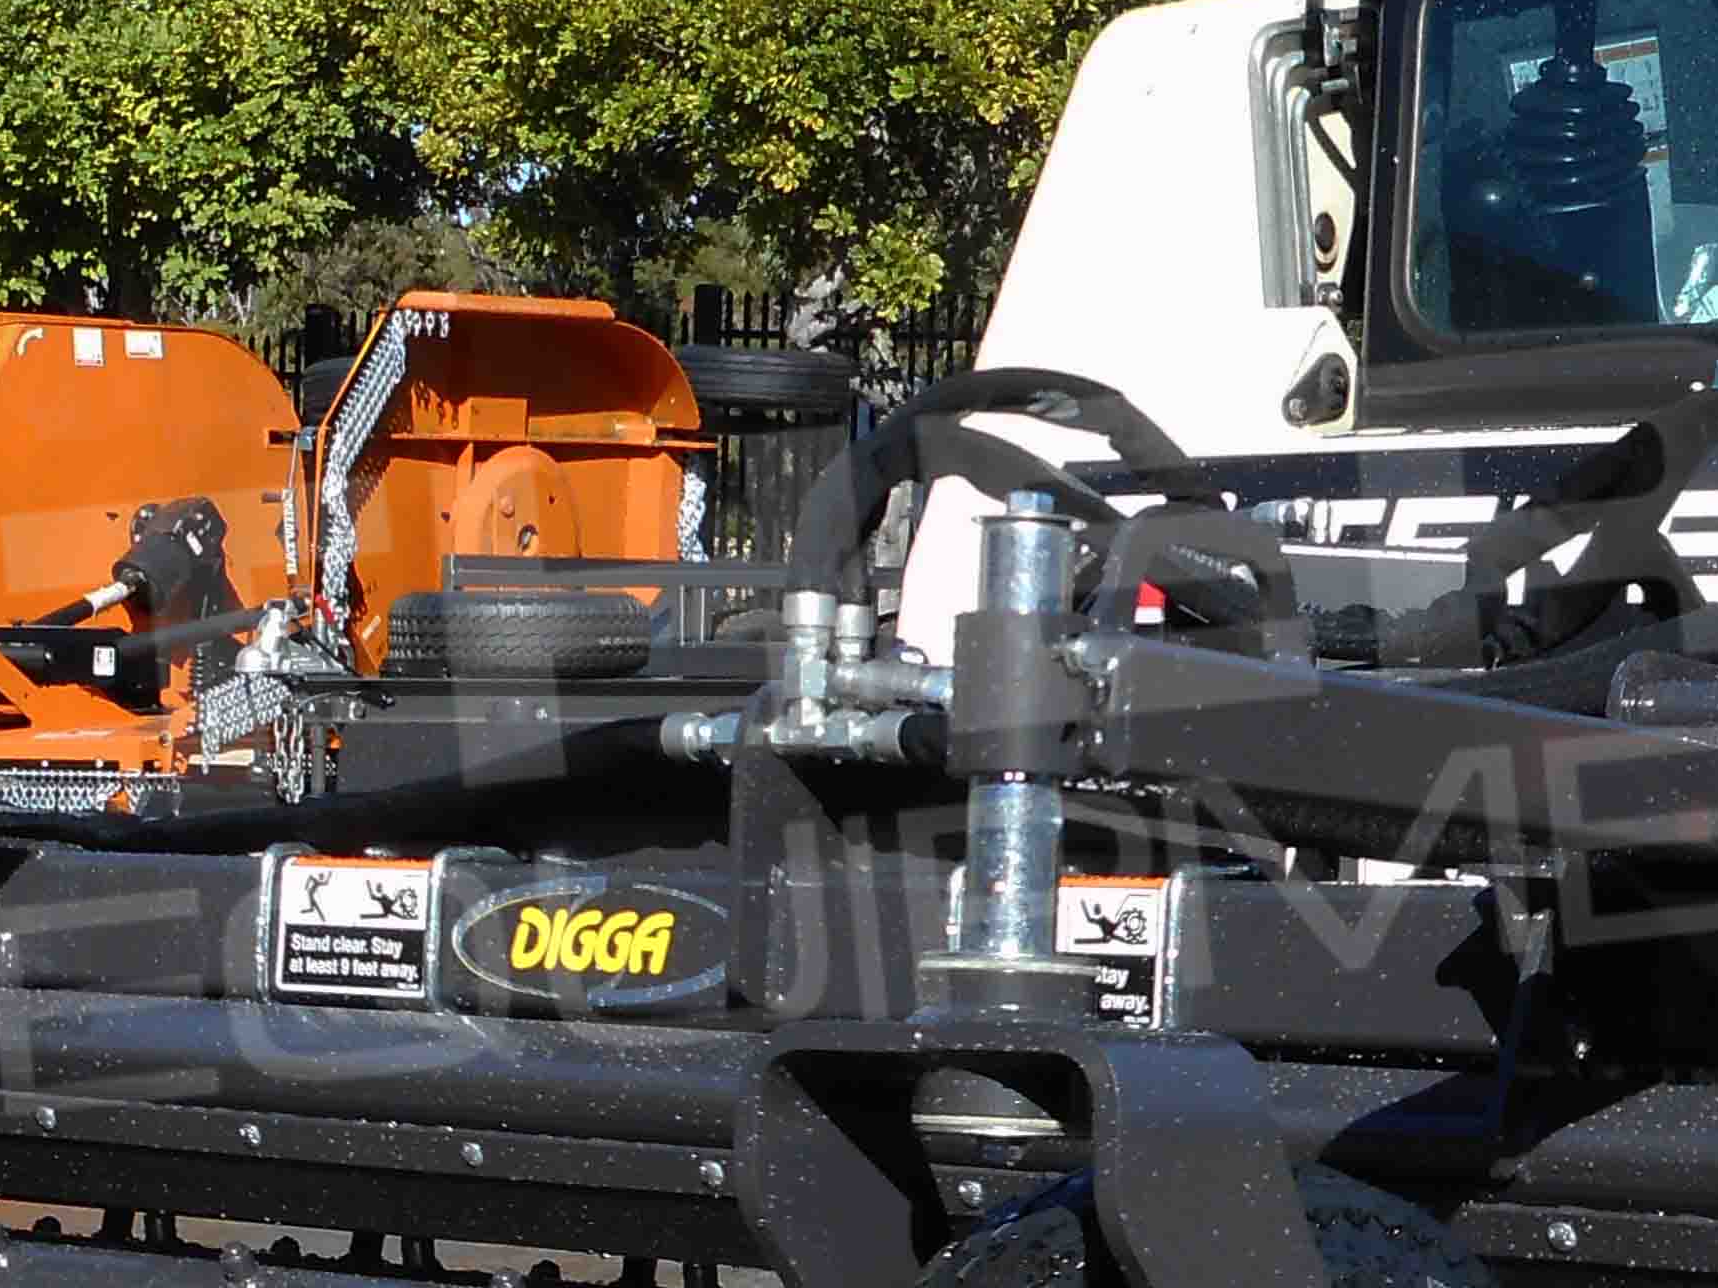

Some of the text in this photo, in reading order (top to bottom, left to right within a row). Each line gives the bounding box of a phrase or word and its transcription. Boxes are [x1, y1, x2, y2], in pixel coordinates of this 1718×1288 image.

[290, 932, 403, 958] Stand clear. Stay
[510, 905, 675, 976] DIGGA
[289, 958, 419, 982] at least 9 feet away.
[1099, 994, 1150, 1015] away.
